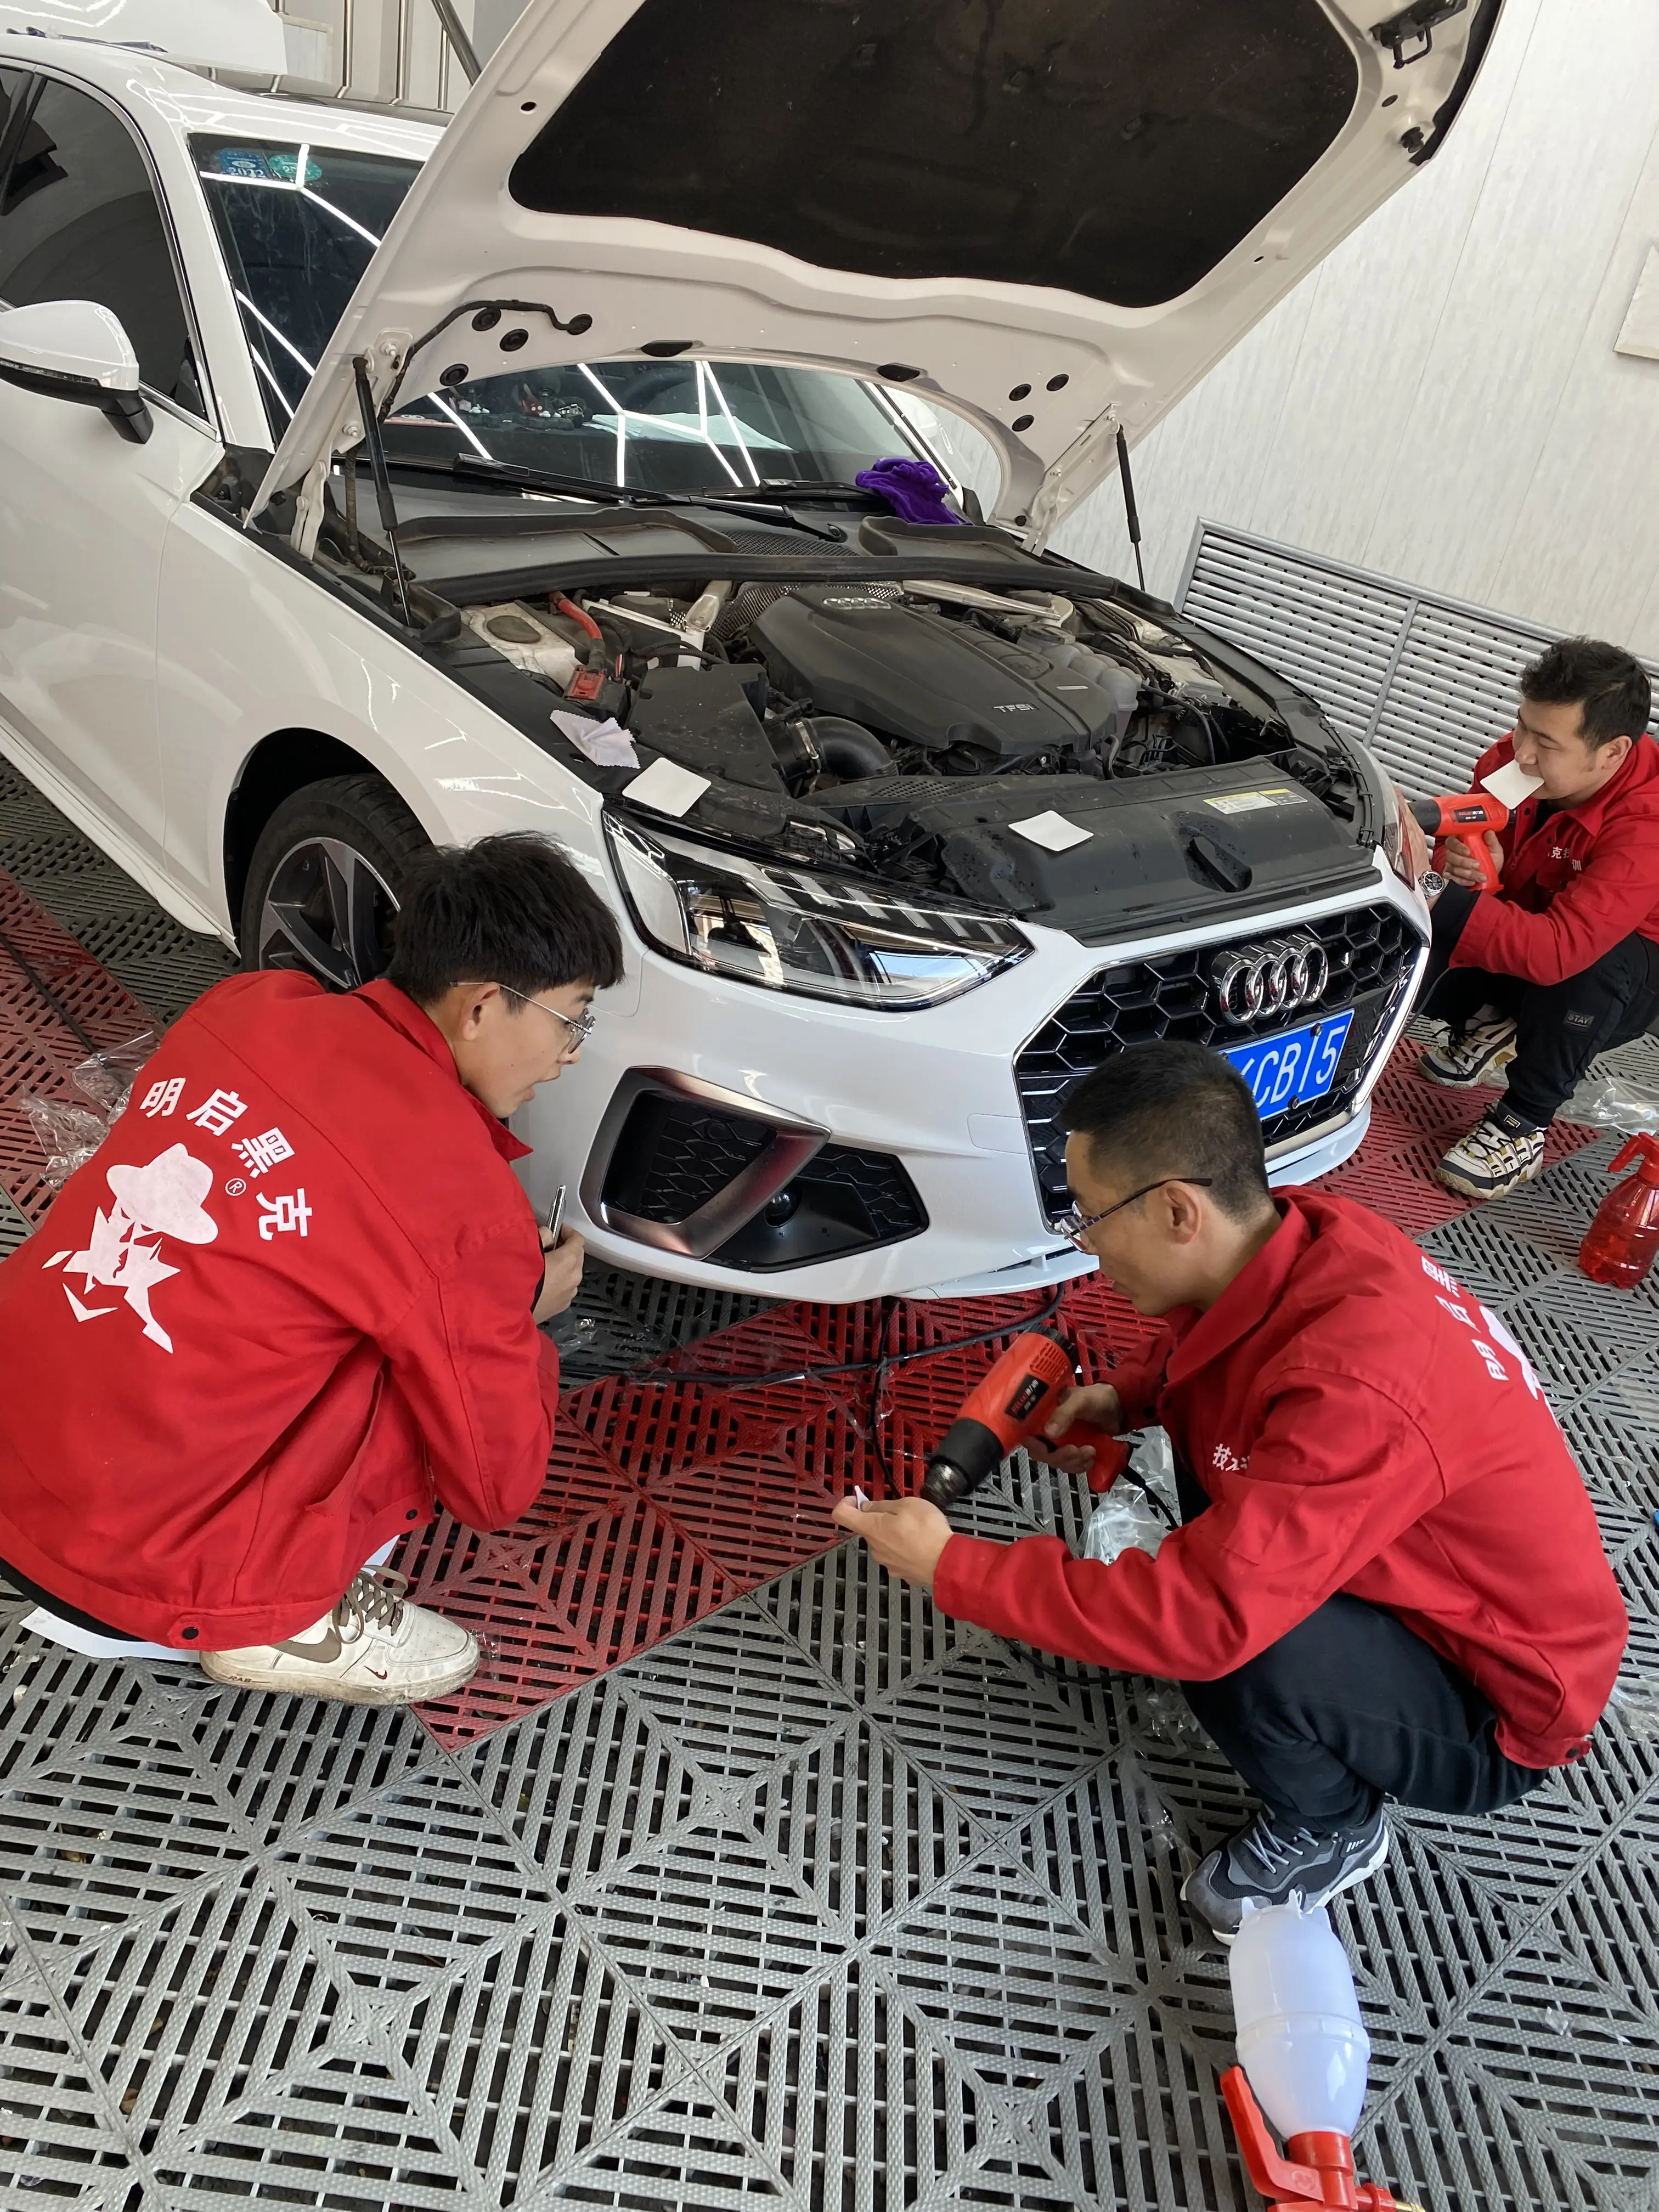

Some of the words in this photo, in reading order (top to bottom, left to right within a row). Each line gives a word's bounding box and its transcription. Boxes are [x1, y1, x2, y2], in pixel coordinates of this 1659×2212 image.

[993, 703, 1034, 713] TFSI
[1568, 1013, 1590, 1024] STAY
[139, 1076, 313, 1241] 明启黑克
